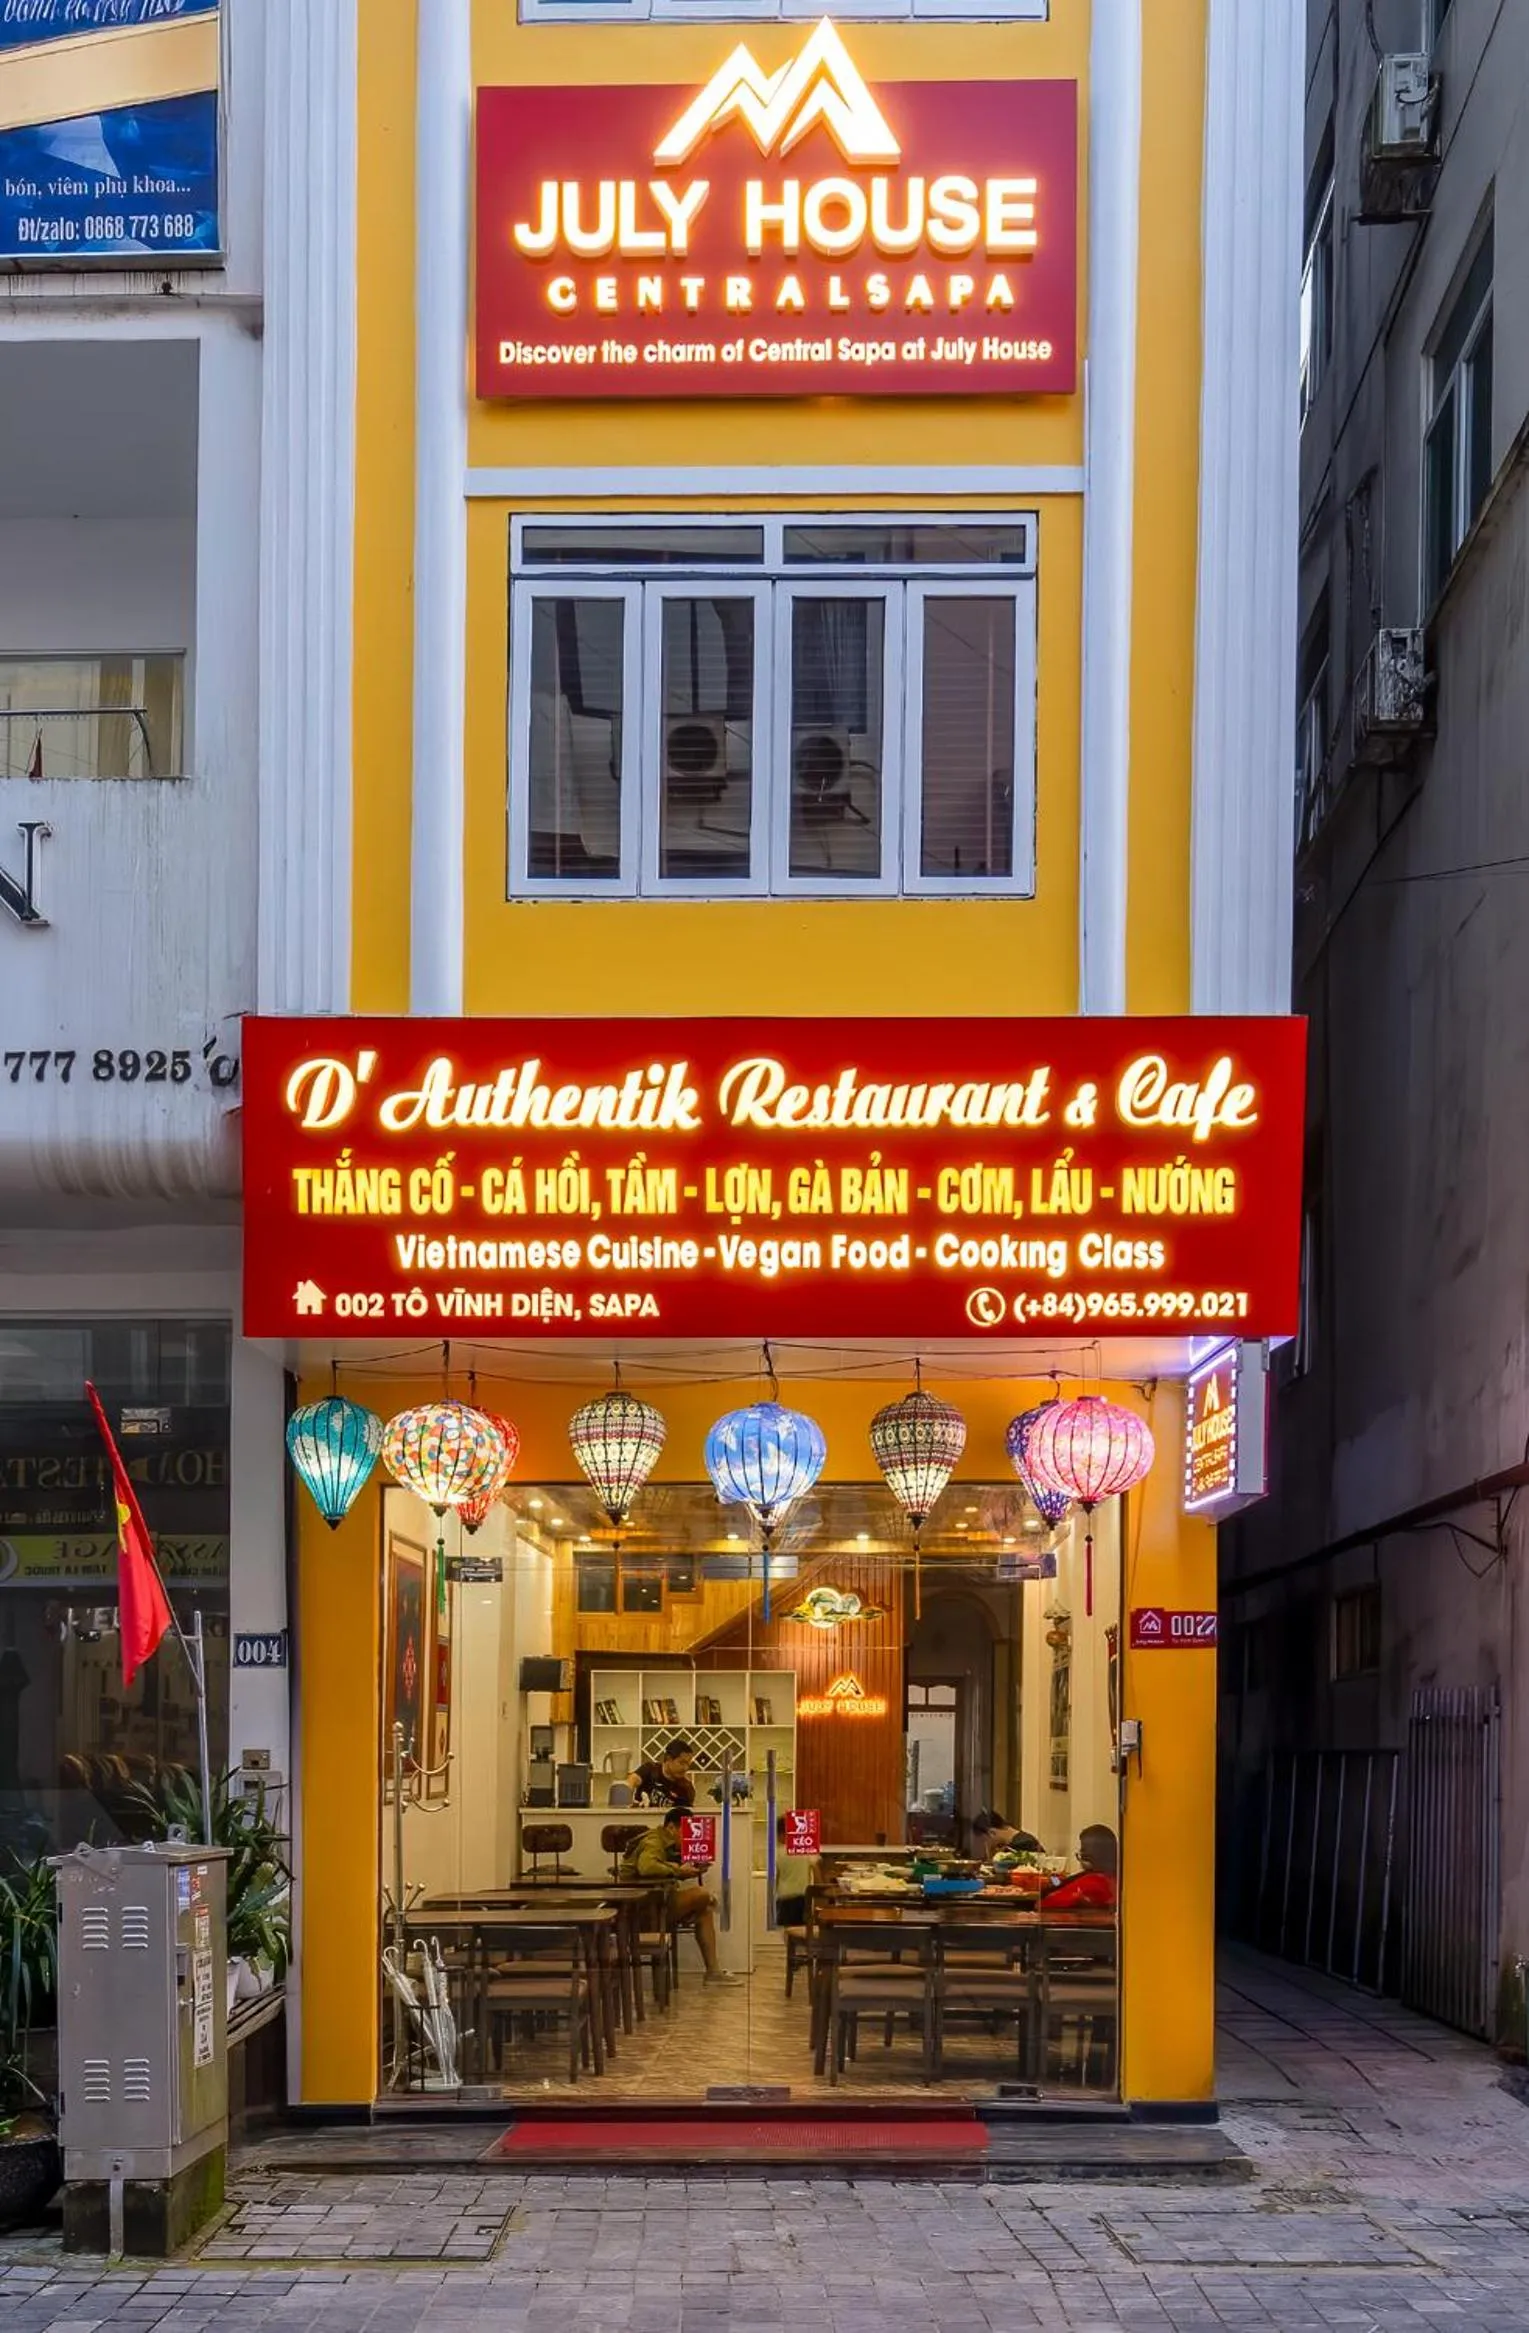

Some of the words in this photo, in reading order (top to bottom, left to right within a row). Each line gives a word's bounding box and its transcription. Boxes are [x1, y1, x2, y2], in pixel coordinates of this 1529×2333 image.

[48, 177, 88, 195] viêm
[94, 178, 127, 199] phụ
[85, 216, 124, 240] 0868
[129, 215, 158, 238] 773
[164, 214, 194, 237] 688
[514, 179, 710, 257] JULY
[744, 176, 1038, 256] HOUSE
[499, 340, 597, 364] Discover
[600, 341, 638, 363] the
[644, 340, 716, 363] charm
[722, 339, 744, 363] of
[748, 339, 833, 362] Central
[838, 339, 896, 367] Sapa
[901, 339, 926, 361] at
[930, 338, 976, 366] July
[982, 338, 1052, 360] House
[287, 1051, 378, 1128] D'
[380, 1057, 701, 1131] Authentik
[720, 1056, 1051, 1128] Restaurant
[1064, 1082, 1097, 1128] &
[1117, 1055, 1258, 1141] Cafe
[292, 1148, 401, 1214] THẮNG
[409, 1151, 456, 1214] CỐ
[482, 1156, 527, 1214] CÁ
[536, 1151, 600, 1221] HỒI,
[606, 1152, 678, 1214] TẦM
[705, 1163, 781, 1225] LỢN,
[788, 1160, 832, 1214] GÀ
[842, 1151, 908, 1214] BẢN
[938, 1162, 1023, 1220] CƠM,
[1031, 1148, 1093, 1214] LẨU
[1123, 1156, 1235, 1214] NƯỚNG
[396, 1235, 581, 1270] Vietnamese
[588, 1235, 698, 1270] Cuisine
[719, 1235, 820, 1276] Vegan
[832, 1235, 910, 1269] Food
[935, 1234, 1067, 1278] Cooking
[1079, 1234, 1165, 1269] Class
[335, 1293, 385, 1318] 002
[392, 1288, 429, 1318] TÔ
[436, 1289, 503, 1317] VĨNH
[511, 1289, 582, 1323] DIỆN,
[589, 1292, 660, 1318] SAPA
[1013, 1292, 1248, 1324] (+84)965.999.021
[238, 1640, 281, 1664] 004
